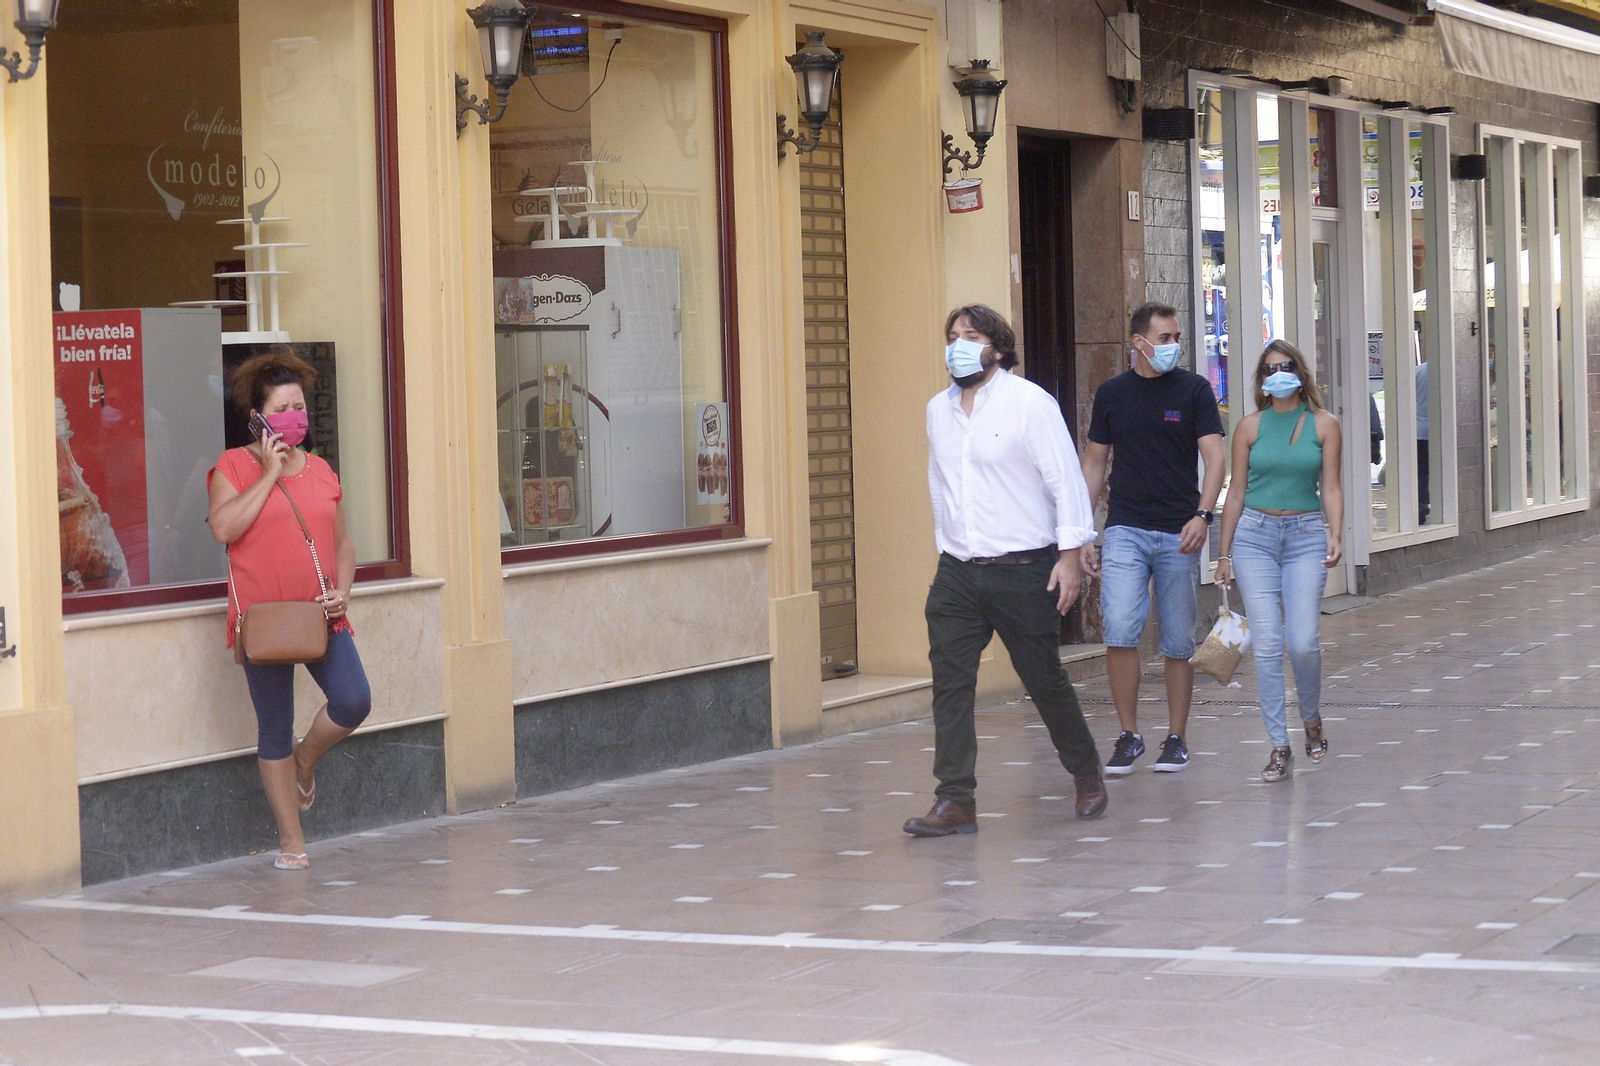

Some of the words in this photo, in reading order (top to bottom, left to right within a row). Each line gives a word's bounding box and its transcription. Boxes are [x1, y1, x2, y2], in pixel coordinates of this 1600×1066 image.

[164, 152, 266, 190] modelo
[566, 178, 638, 208] modelo
[56, 322, 135, 341] ¡Llévatela
[60, 346, 96, 362] bien
[99, 344, 132, 361] fría!
